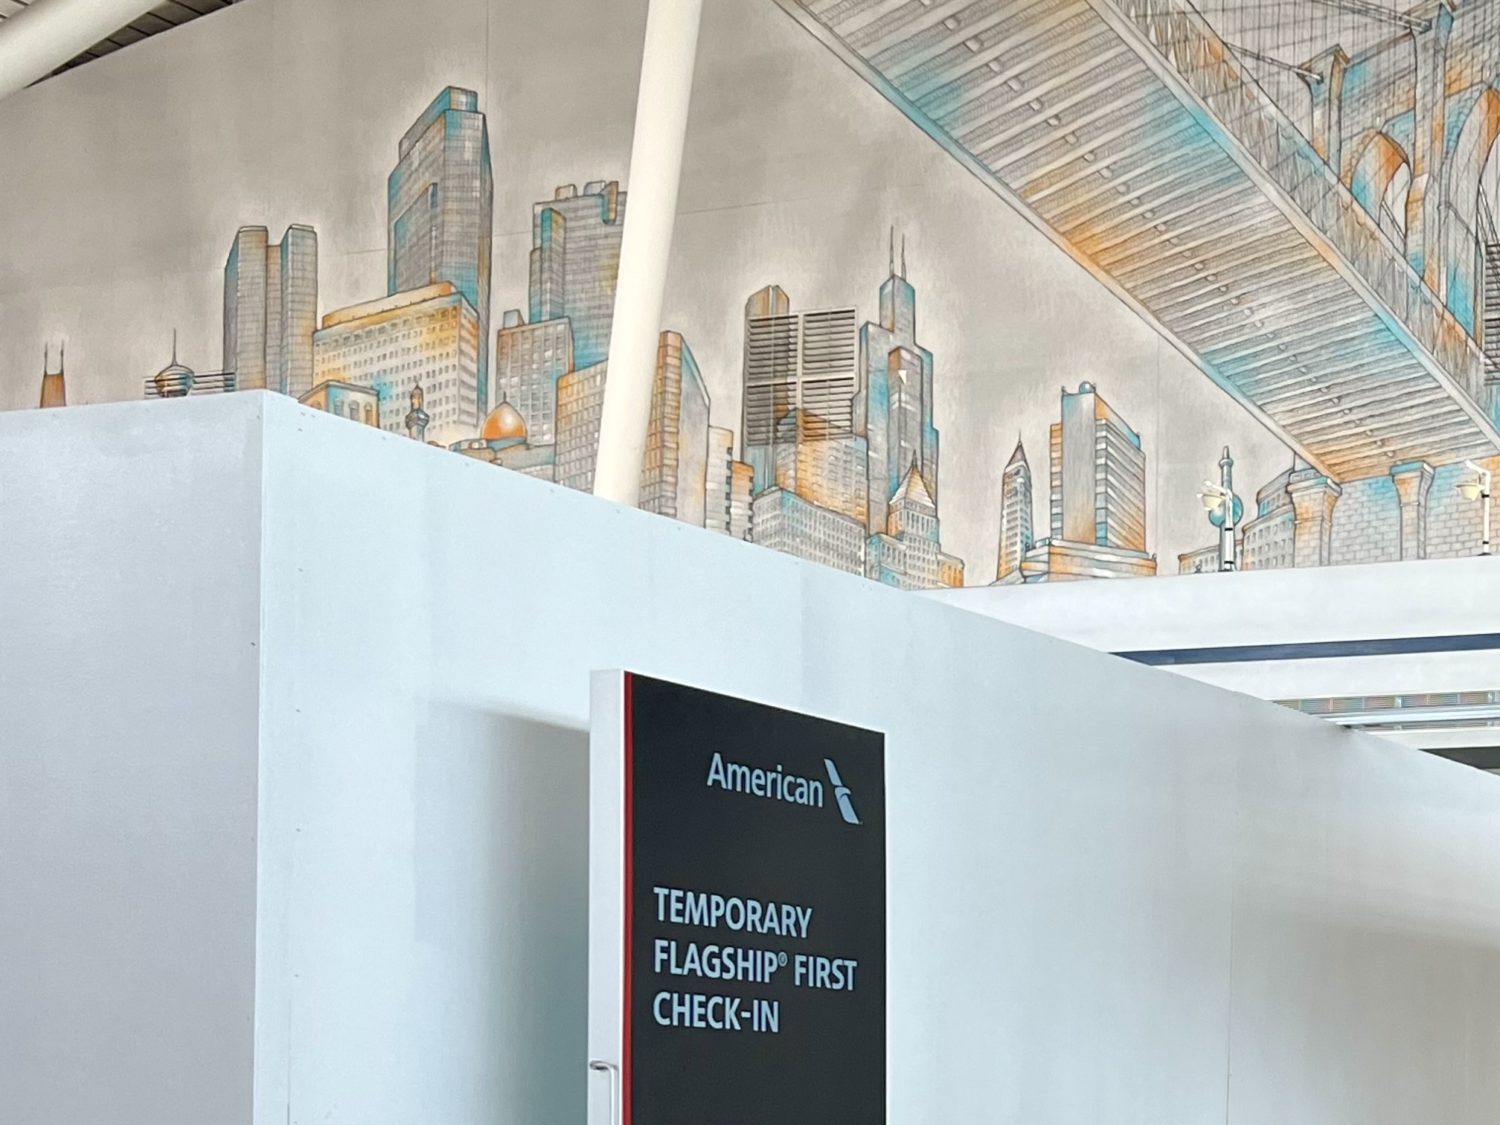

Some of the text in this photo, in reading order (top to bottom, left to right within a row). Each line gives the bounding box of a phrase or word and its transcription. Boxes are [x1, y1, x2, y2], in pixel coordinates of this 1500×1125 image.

[706, 752, 823, 808] American
[653, 886, 813, 938] TEMPORARY
[794, 954, 858, 991] FIRST
[653, 991, 779, 1033] CHECK-IN
